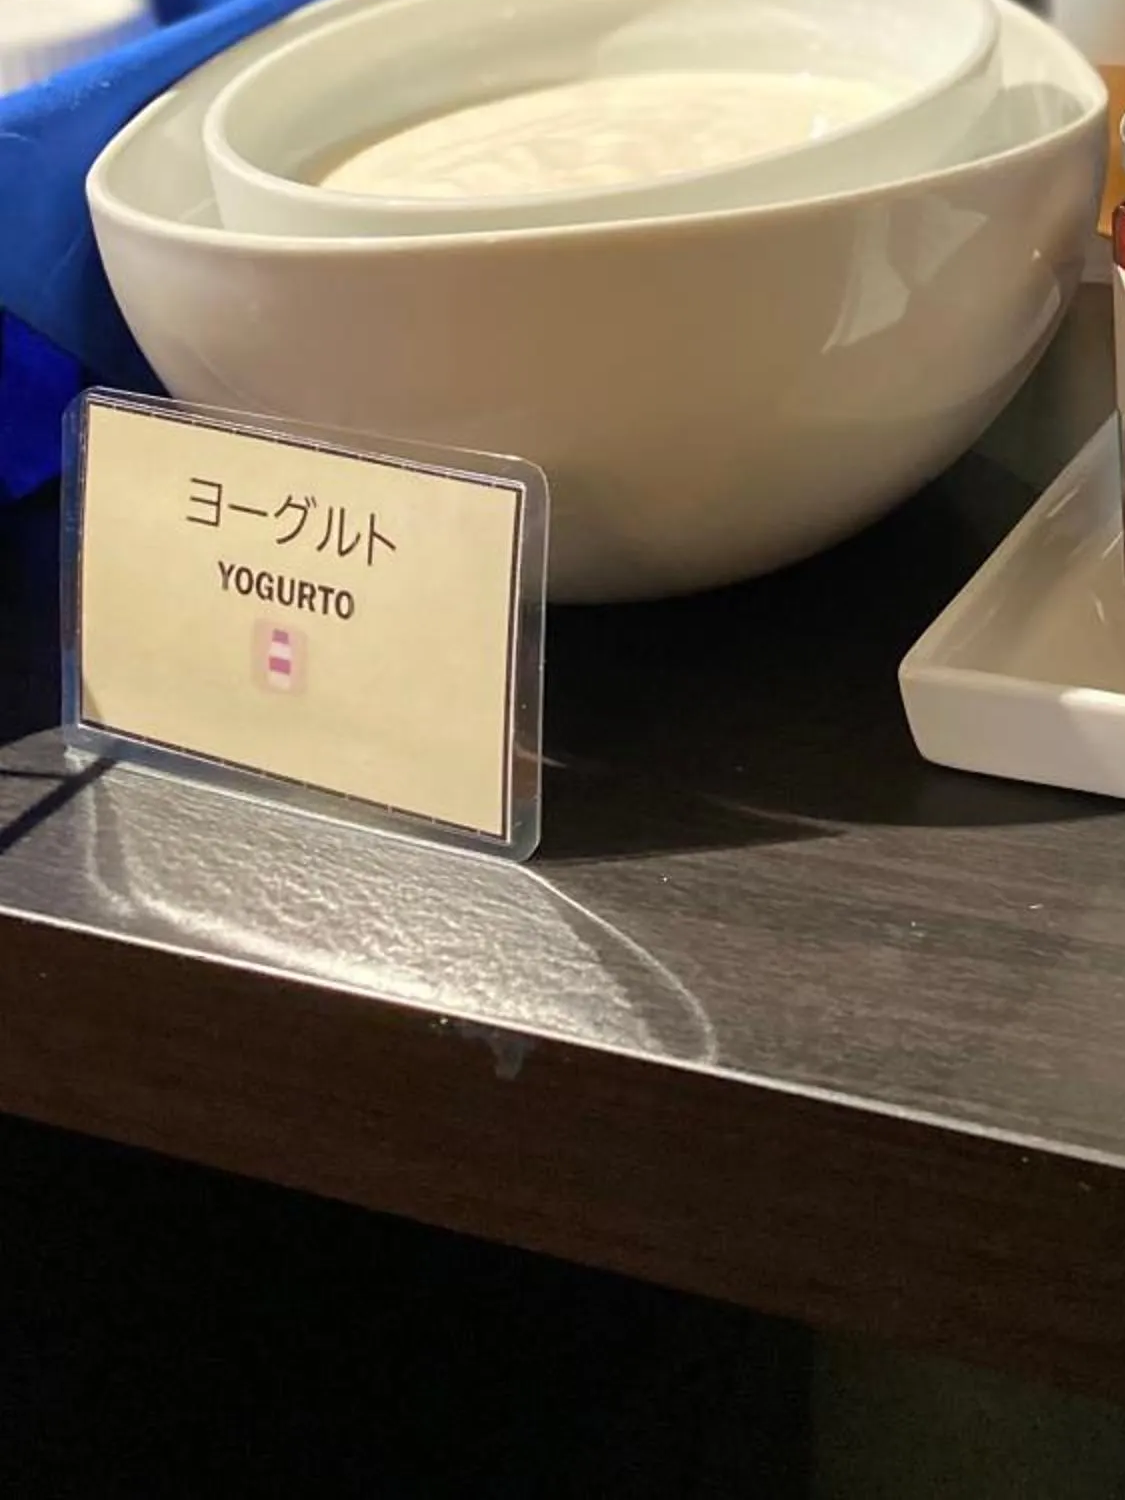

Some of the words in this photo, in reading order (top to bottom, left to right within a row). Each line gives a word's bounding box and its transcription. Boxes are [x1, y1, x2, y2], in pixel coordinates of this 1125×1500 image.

[186, 476, 398, 566] ヨーグルト
[217, 560, 356, 620] YOGURTO
